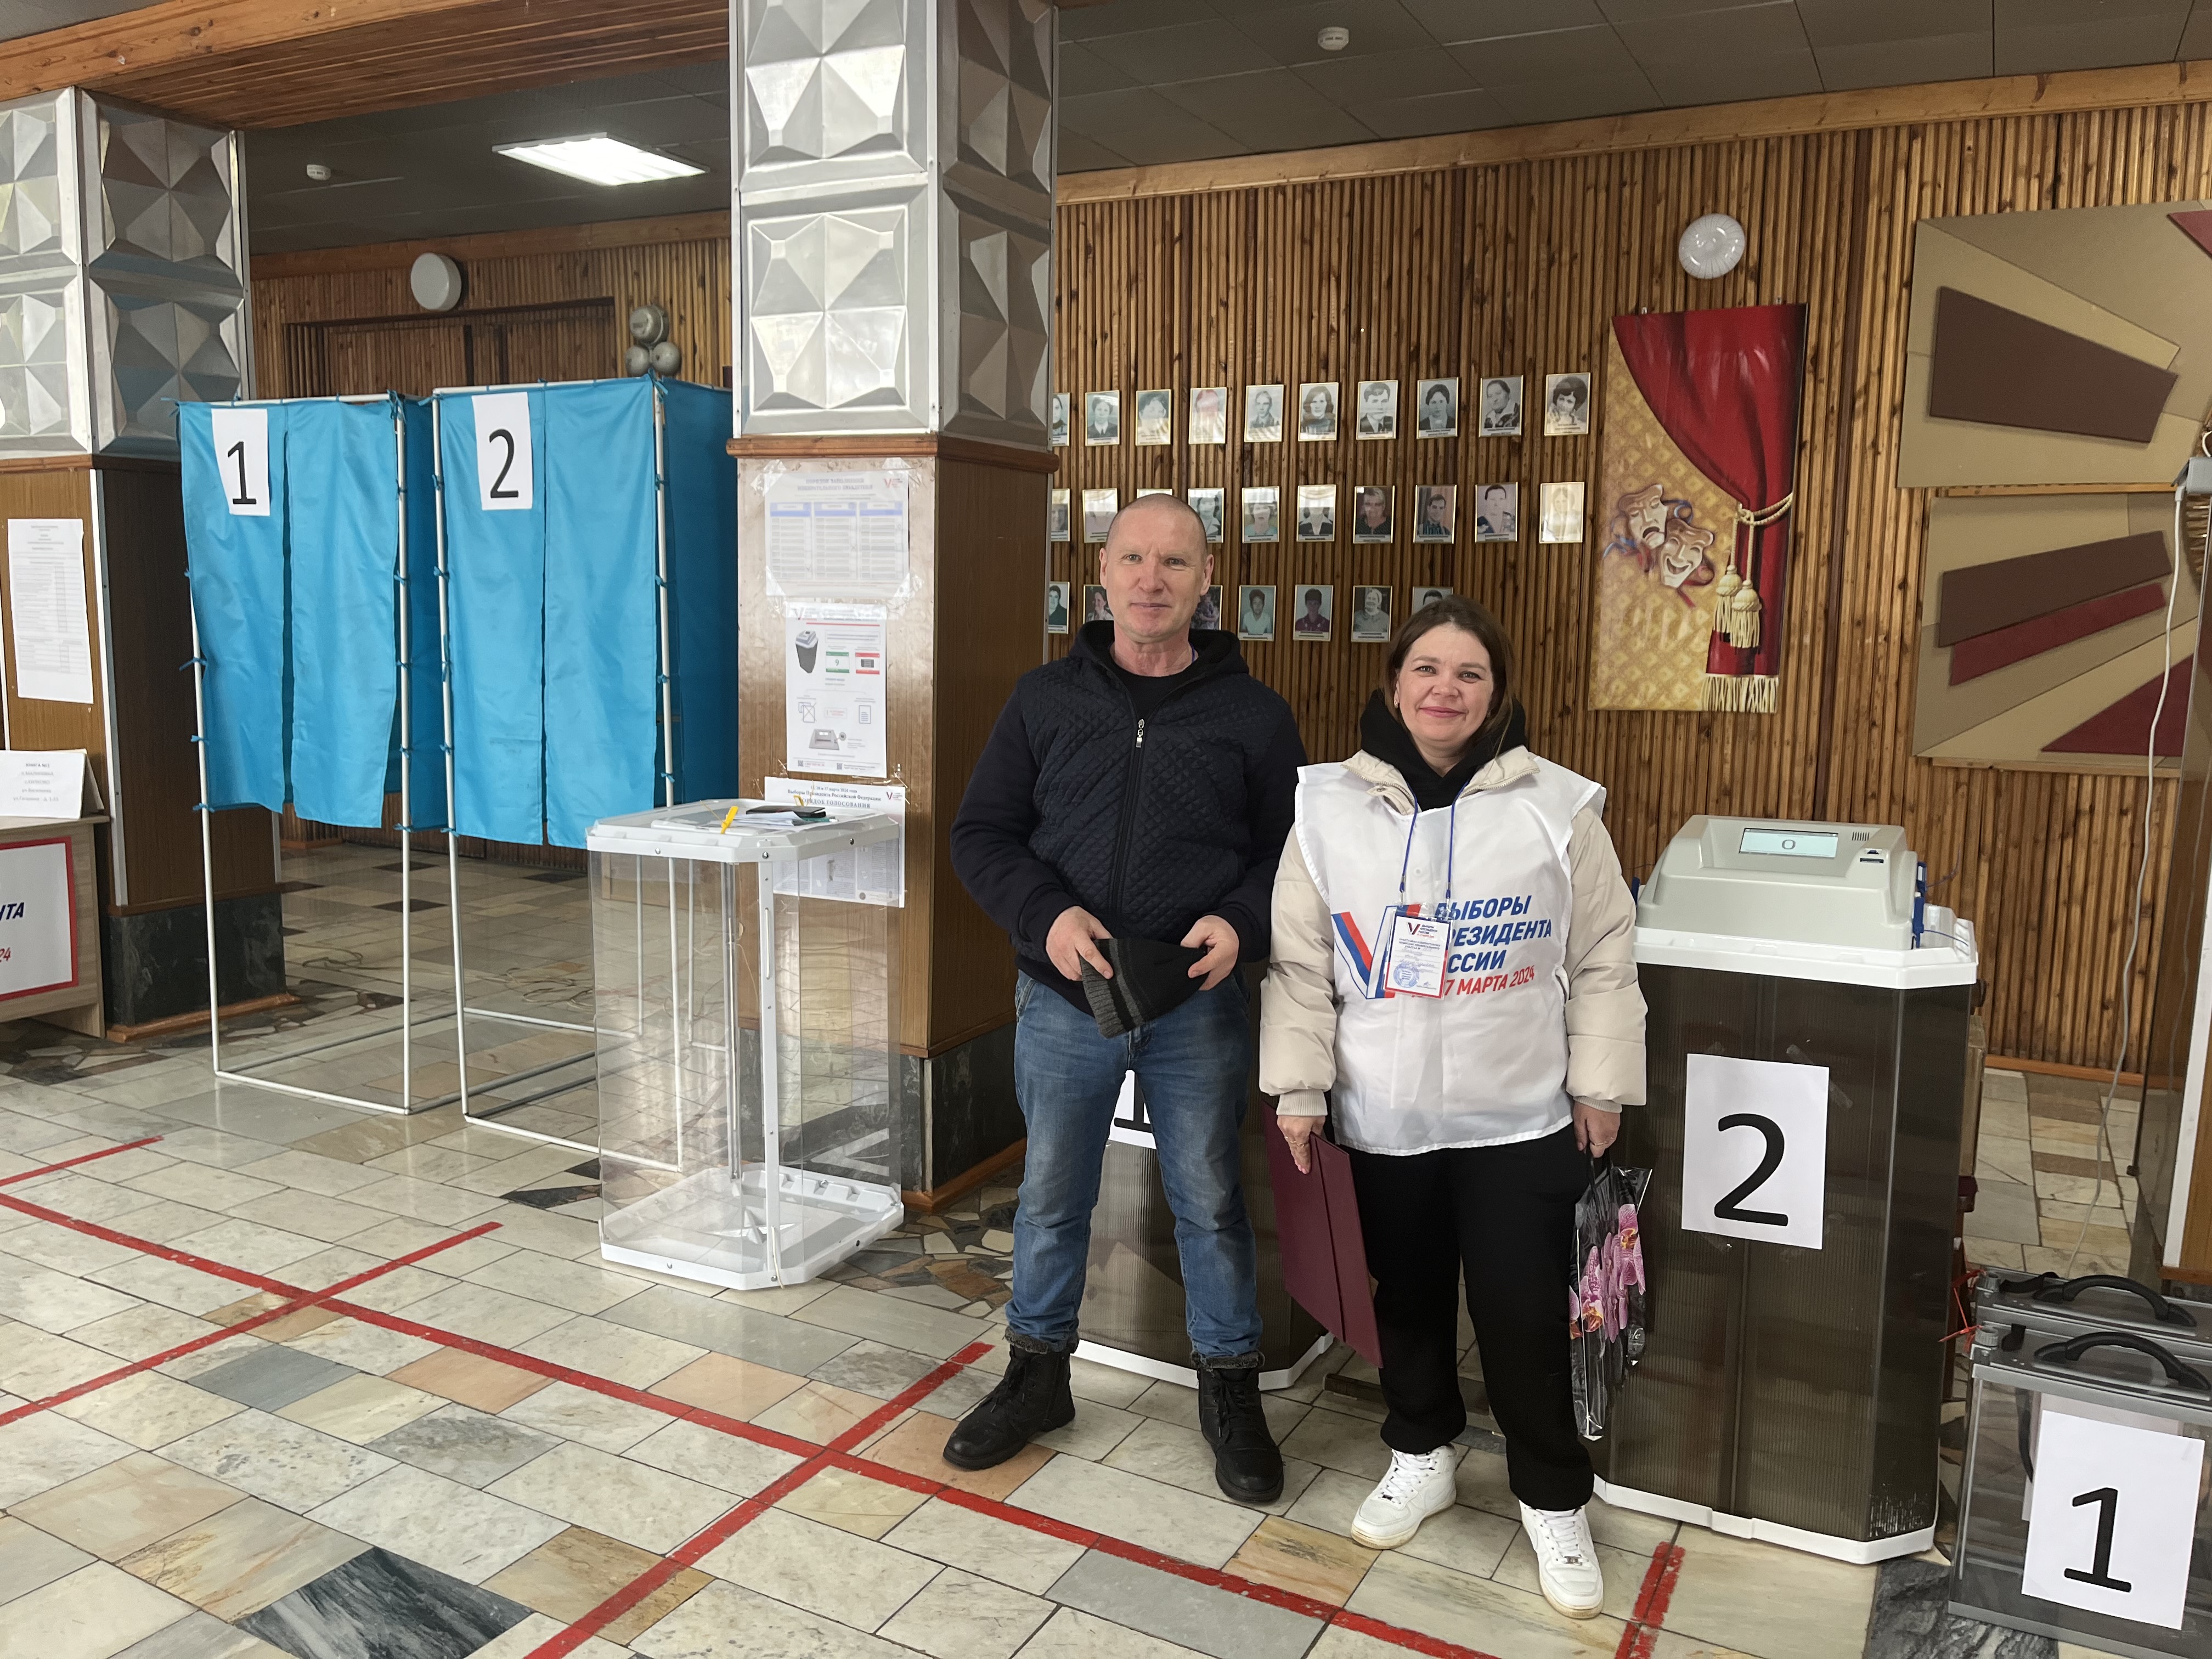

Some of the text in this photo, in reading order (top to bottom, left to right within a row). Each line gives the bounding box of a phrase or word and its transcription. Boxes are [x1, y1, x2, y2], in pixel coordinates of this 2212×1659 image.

[227, 441, 257, 505] 1
[489, 428, 519, 498] 2
[826, 800, 870, 808] ГОЛОСОВАНИЯ
[1452, 919, 1551, 947] ЕЗИДЕНТА
[1447, 950, 1506, 974] ССИИ
[1456, 974, 1508, 996] МАРТА
[1509, 964, 1534, 988] 2024
[1714, 1113, 1788, 1227] 2
[2064, 1487, 2132, 1593] 1
